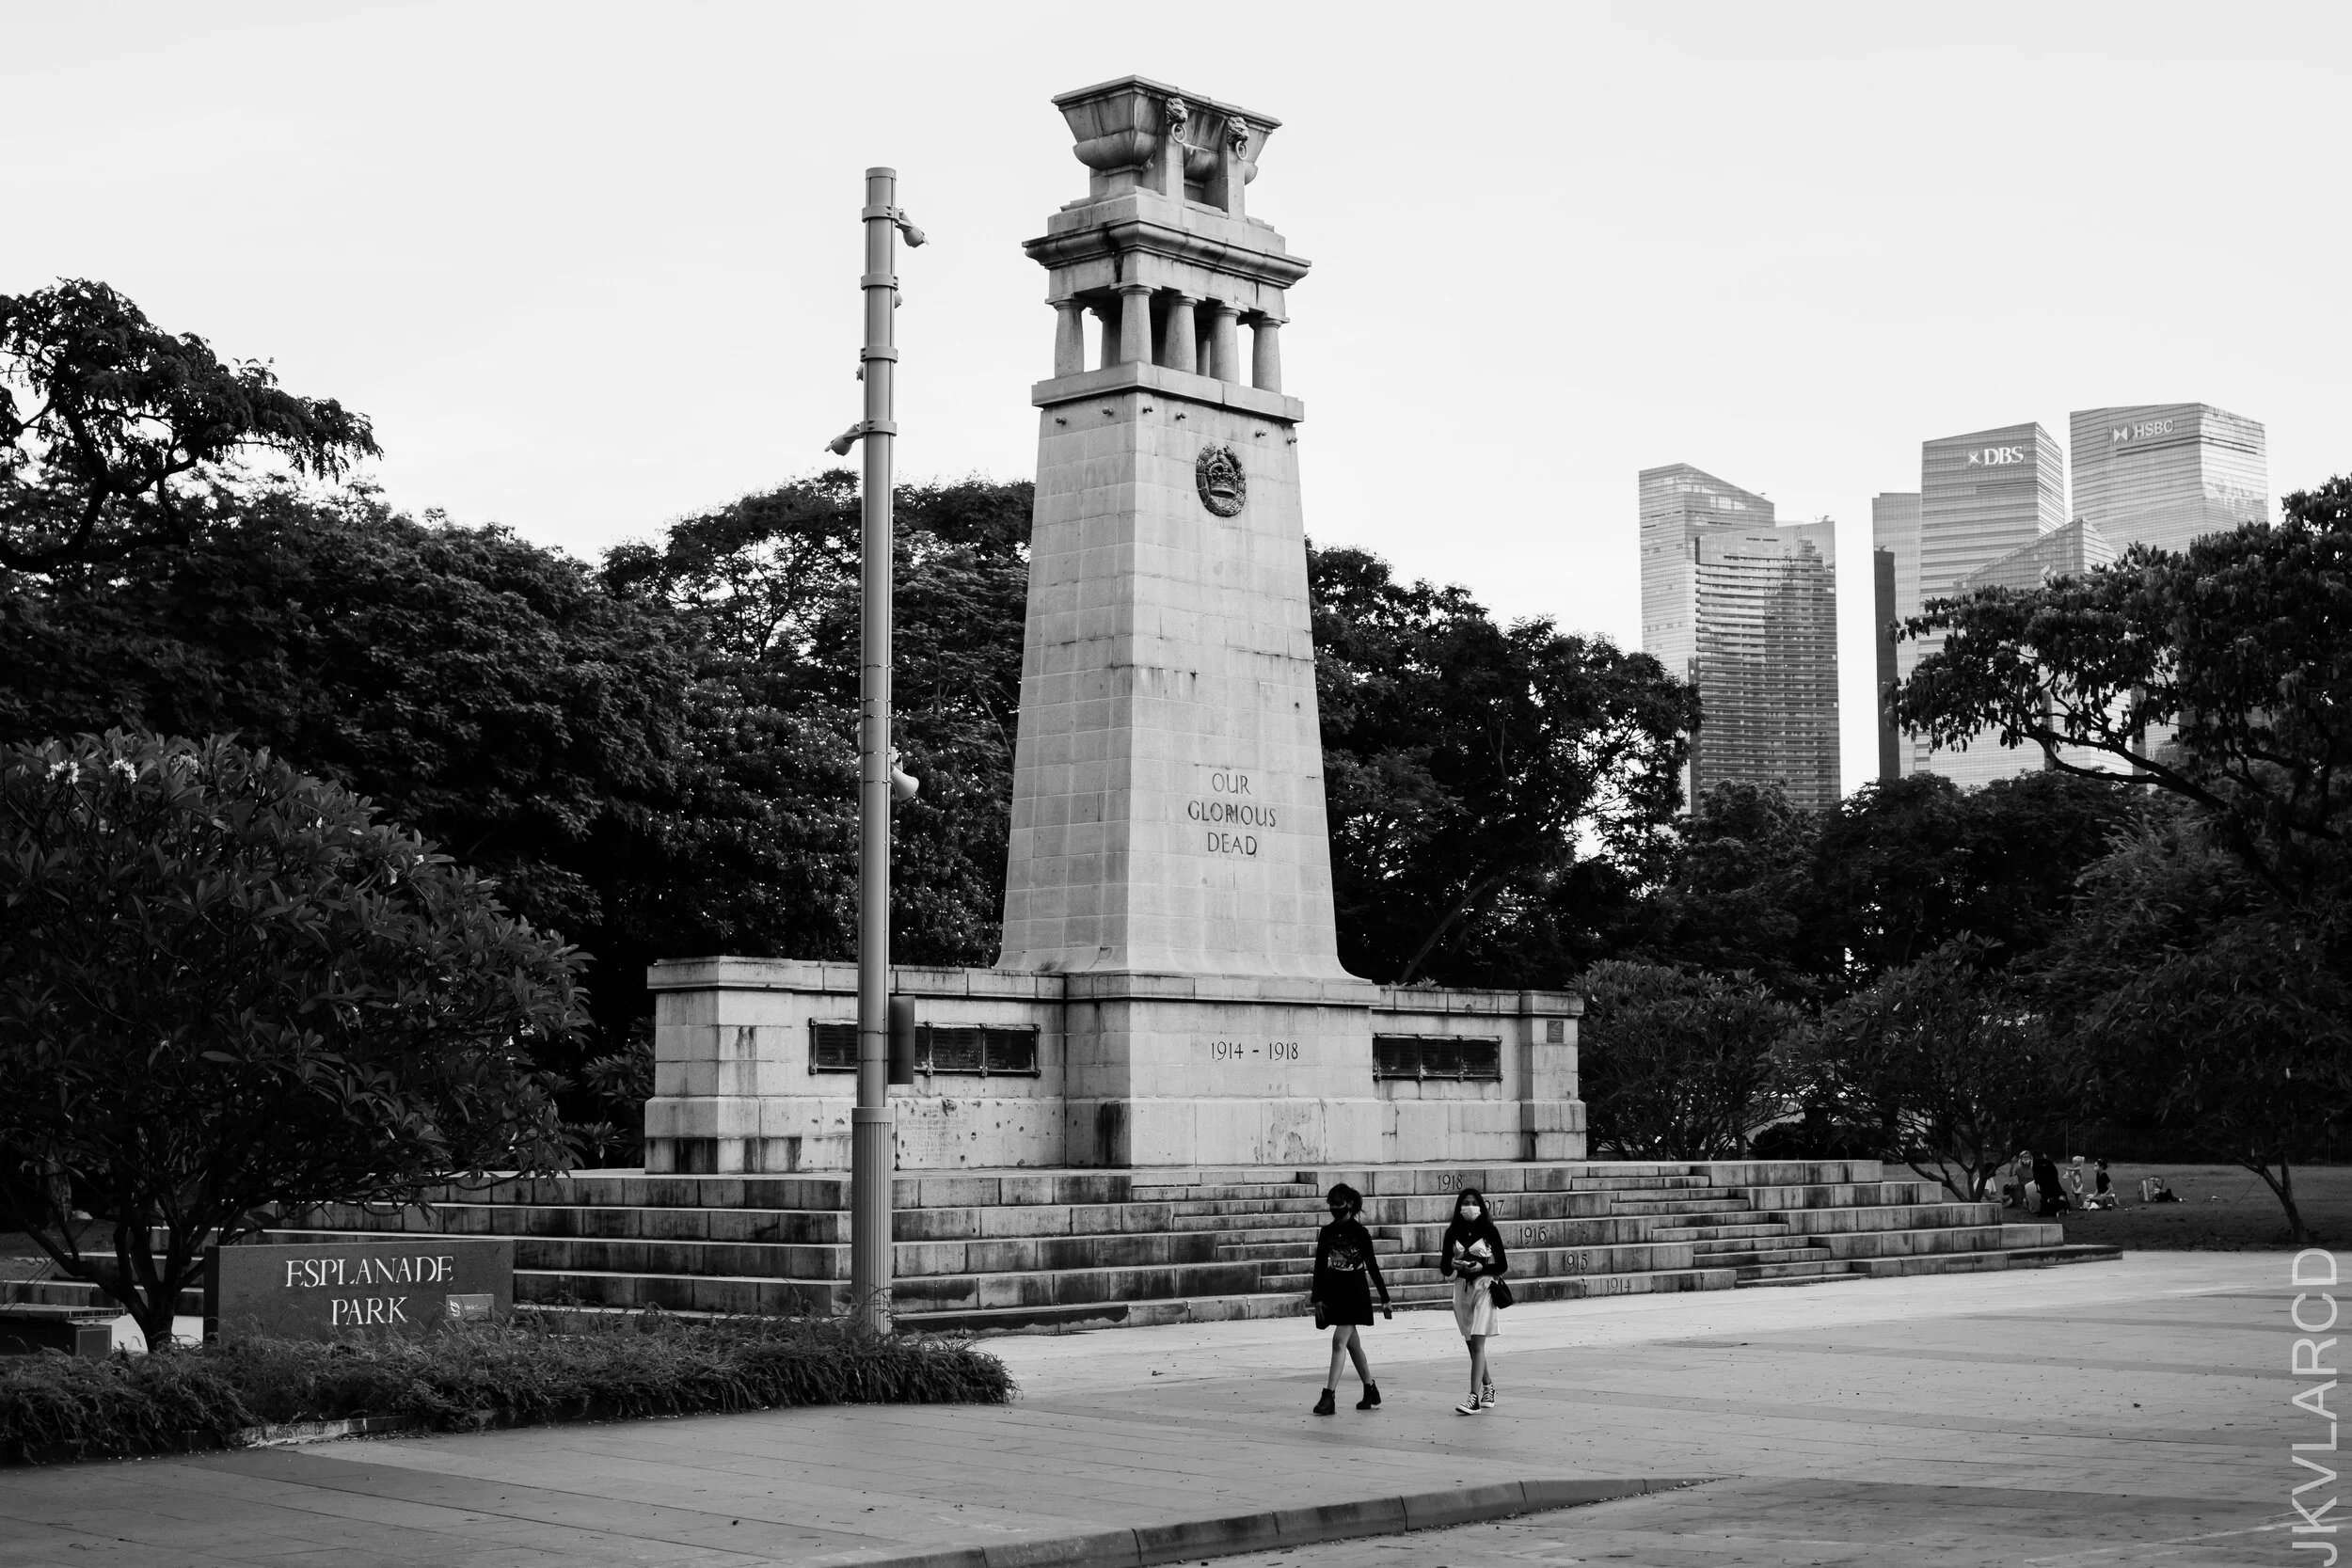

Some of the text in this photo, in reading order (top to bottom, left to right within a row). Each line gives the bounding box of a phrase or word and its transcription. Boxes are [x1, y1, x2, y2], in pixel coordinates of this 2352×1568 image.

[2134, 420, 2175, 438] HSBC
[1984, 446, 2025, 466] DBS
[1213, 773, 1250, 795] OUR
[1188, 800, 1276, 827] GLORIOUS
[1208, 832, 1258, 855] DEAD
[1212, 1041, 1244, 1060] 1914
[1269, 1042, 1298, 1060] 1918
[1438, 1174, 1464, 1191] 1918
[1484, 1199, 1505, 1216] 917
[1519, 1226, 1548, 1244] 1916
[285, 1256, 454, 1288] ESPLANADE
[1562, 1253, 1589, 1272] 1915
[1606, 1277, 1632, 1293] 1914
[331, 1296, 409, 1325] PARK
